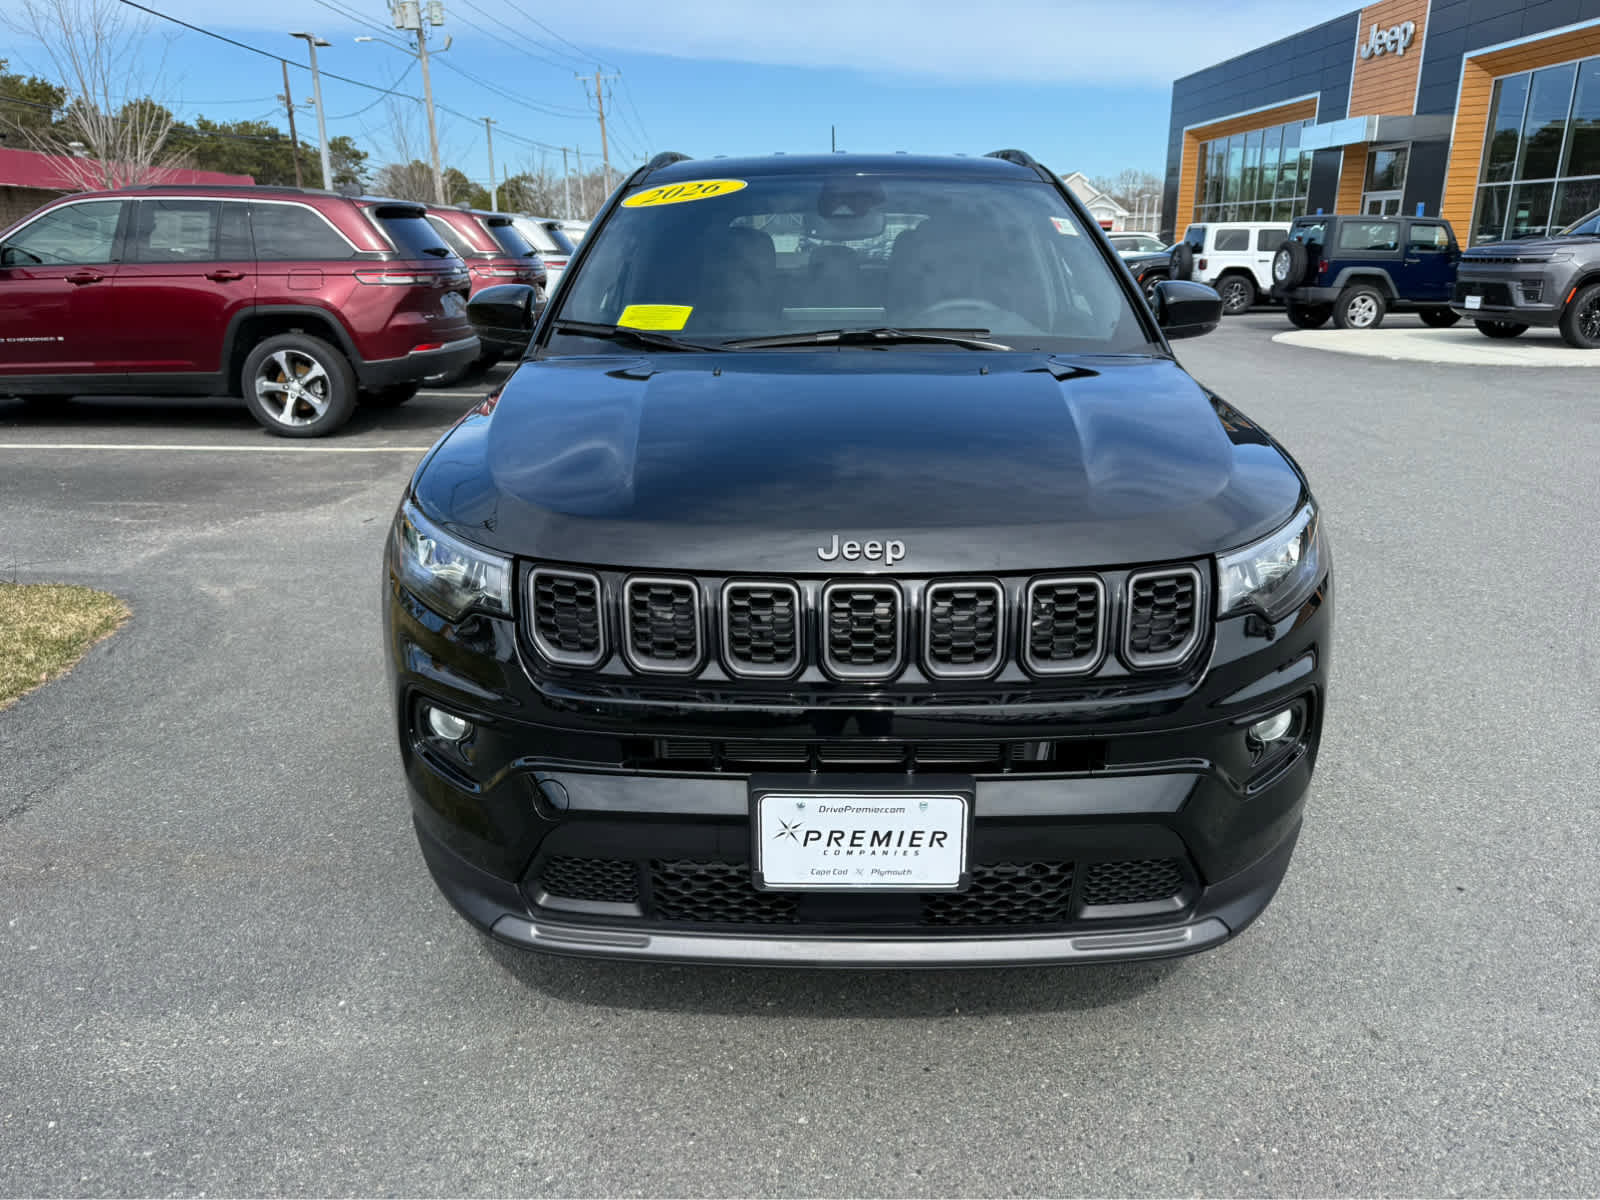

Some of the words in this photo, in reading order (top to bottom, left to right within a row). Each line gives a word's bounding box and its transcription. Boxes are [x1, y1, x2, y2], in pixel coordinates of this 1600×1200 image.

[1361, 21, 1415, 59] Jeep
[641, 181, 726, 203] 2026
[817, 534, 905, 566] Jeep
[818, 804, 906, 814] DrivePremier.com
[802, 829, 949, 848] PREMIER
[823, 849, 921, 857] COMPANIES
[810, 868, 831, 877] Cape
[832, 868, 849, 876] Cod
[870, 868, 913, 877] Plymouth
